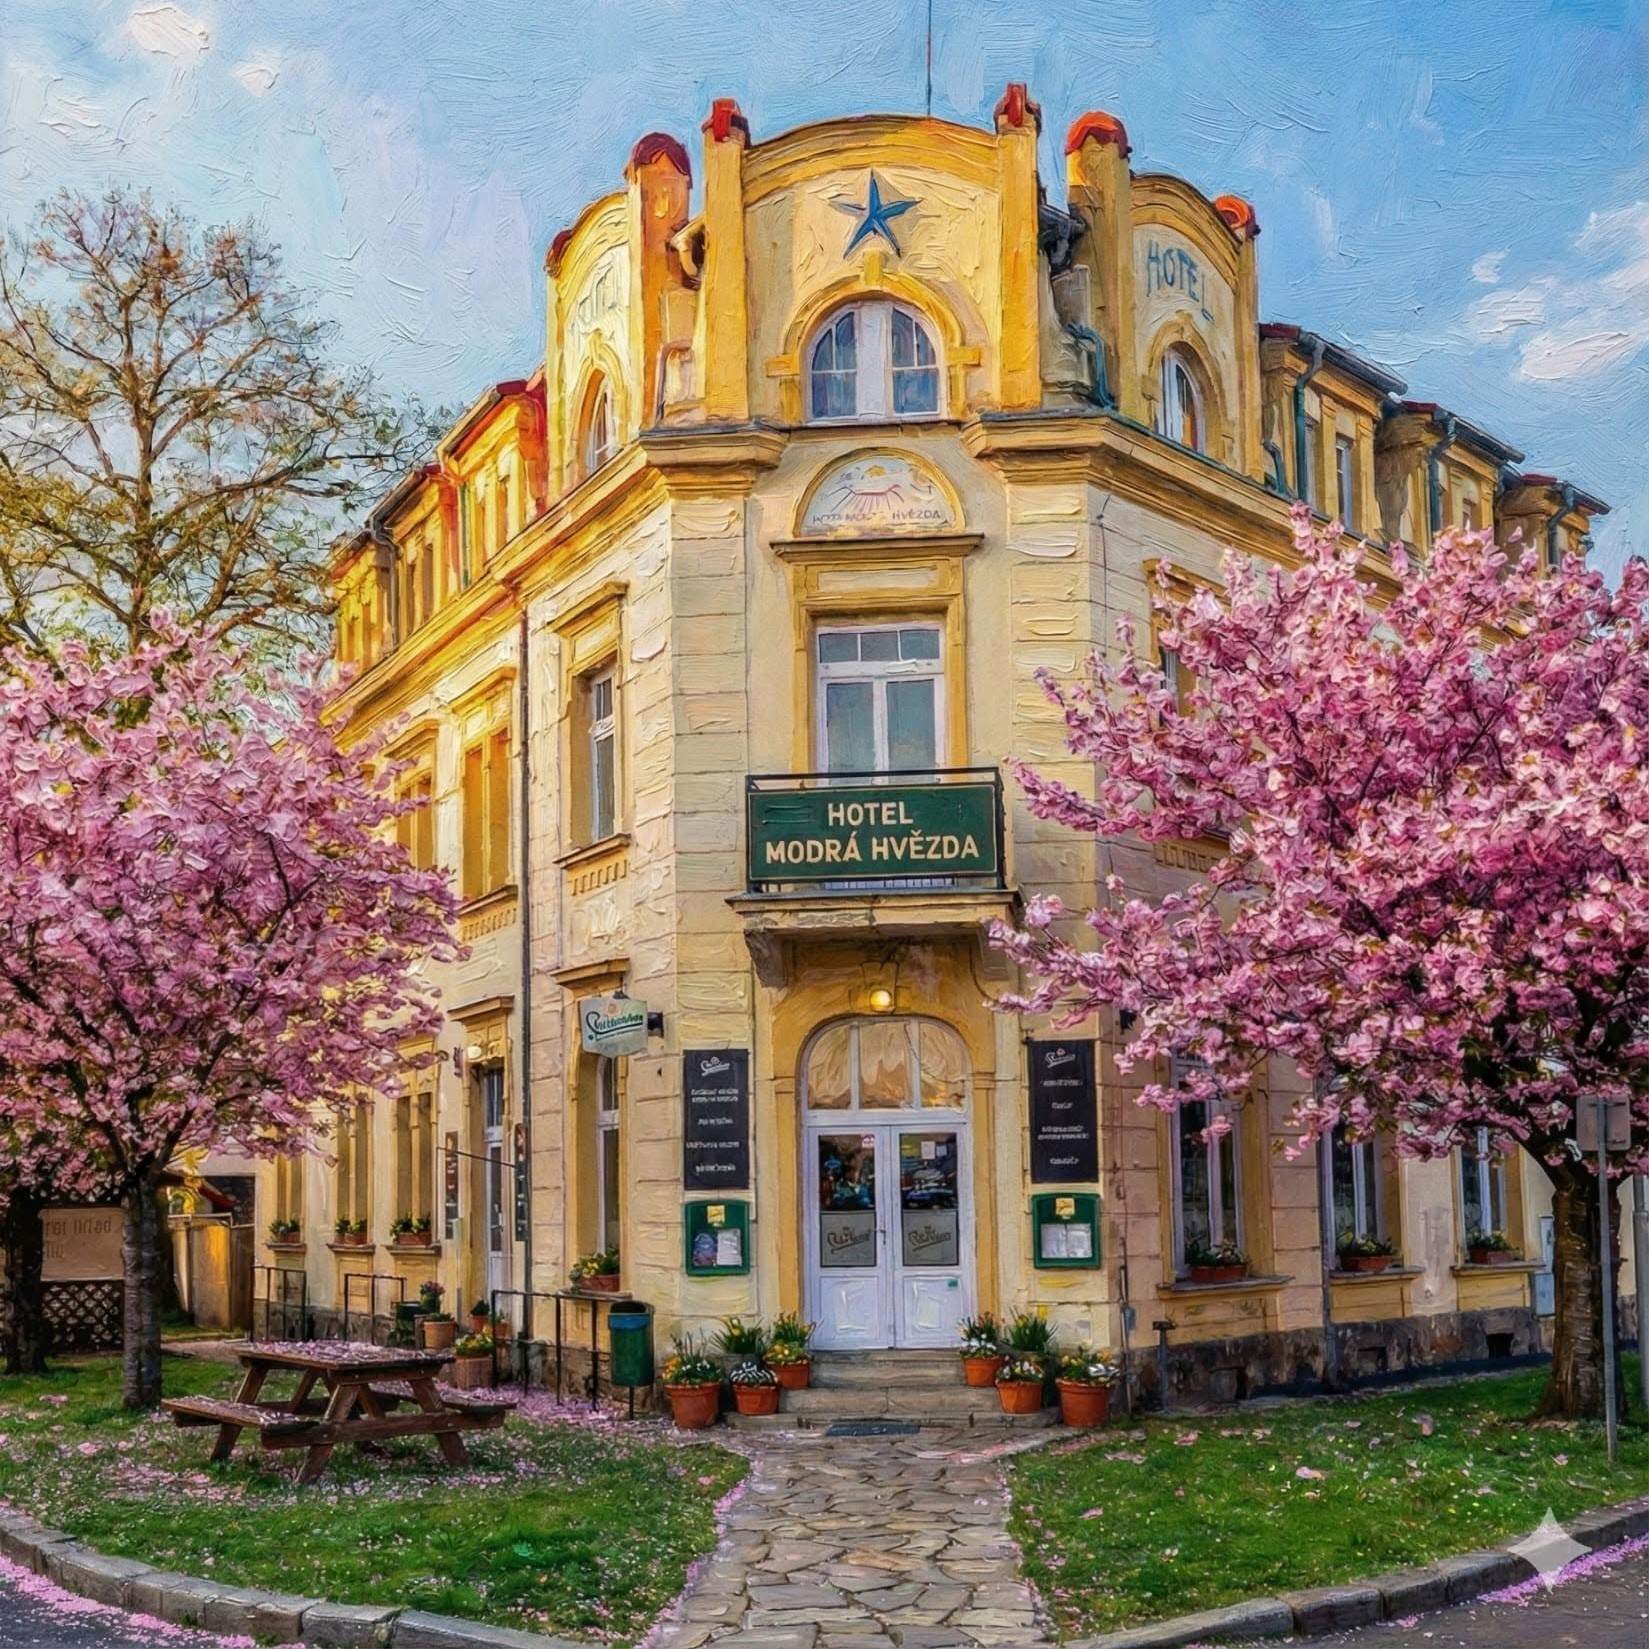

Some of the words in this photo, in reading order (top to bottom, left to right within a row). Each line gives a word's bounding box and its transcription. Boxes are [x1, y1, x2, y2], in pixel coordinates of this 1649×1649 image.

[827, 801, 914, 826] HOTEL
[765, 831, 862, 864] MODRÁ
[871, 829, 980, 861] HVĚZDA
